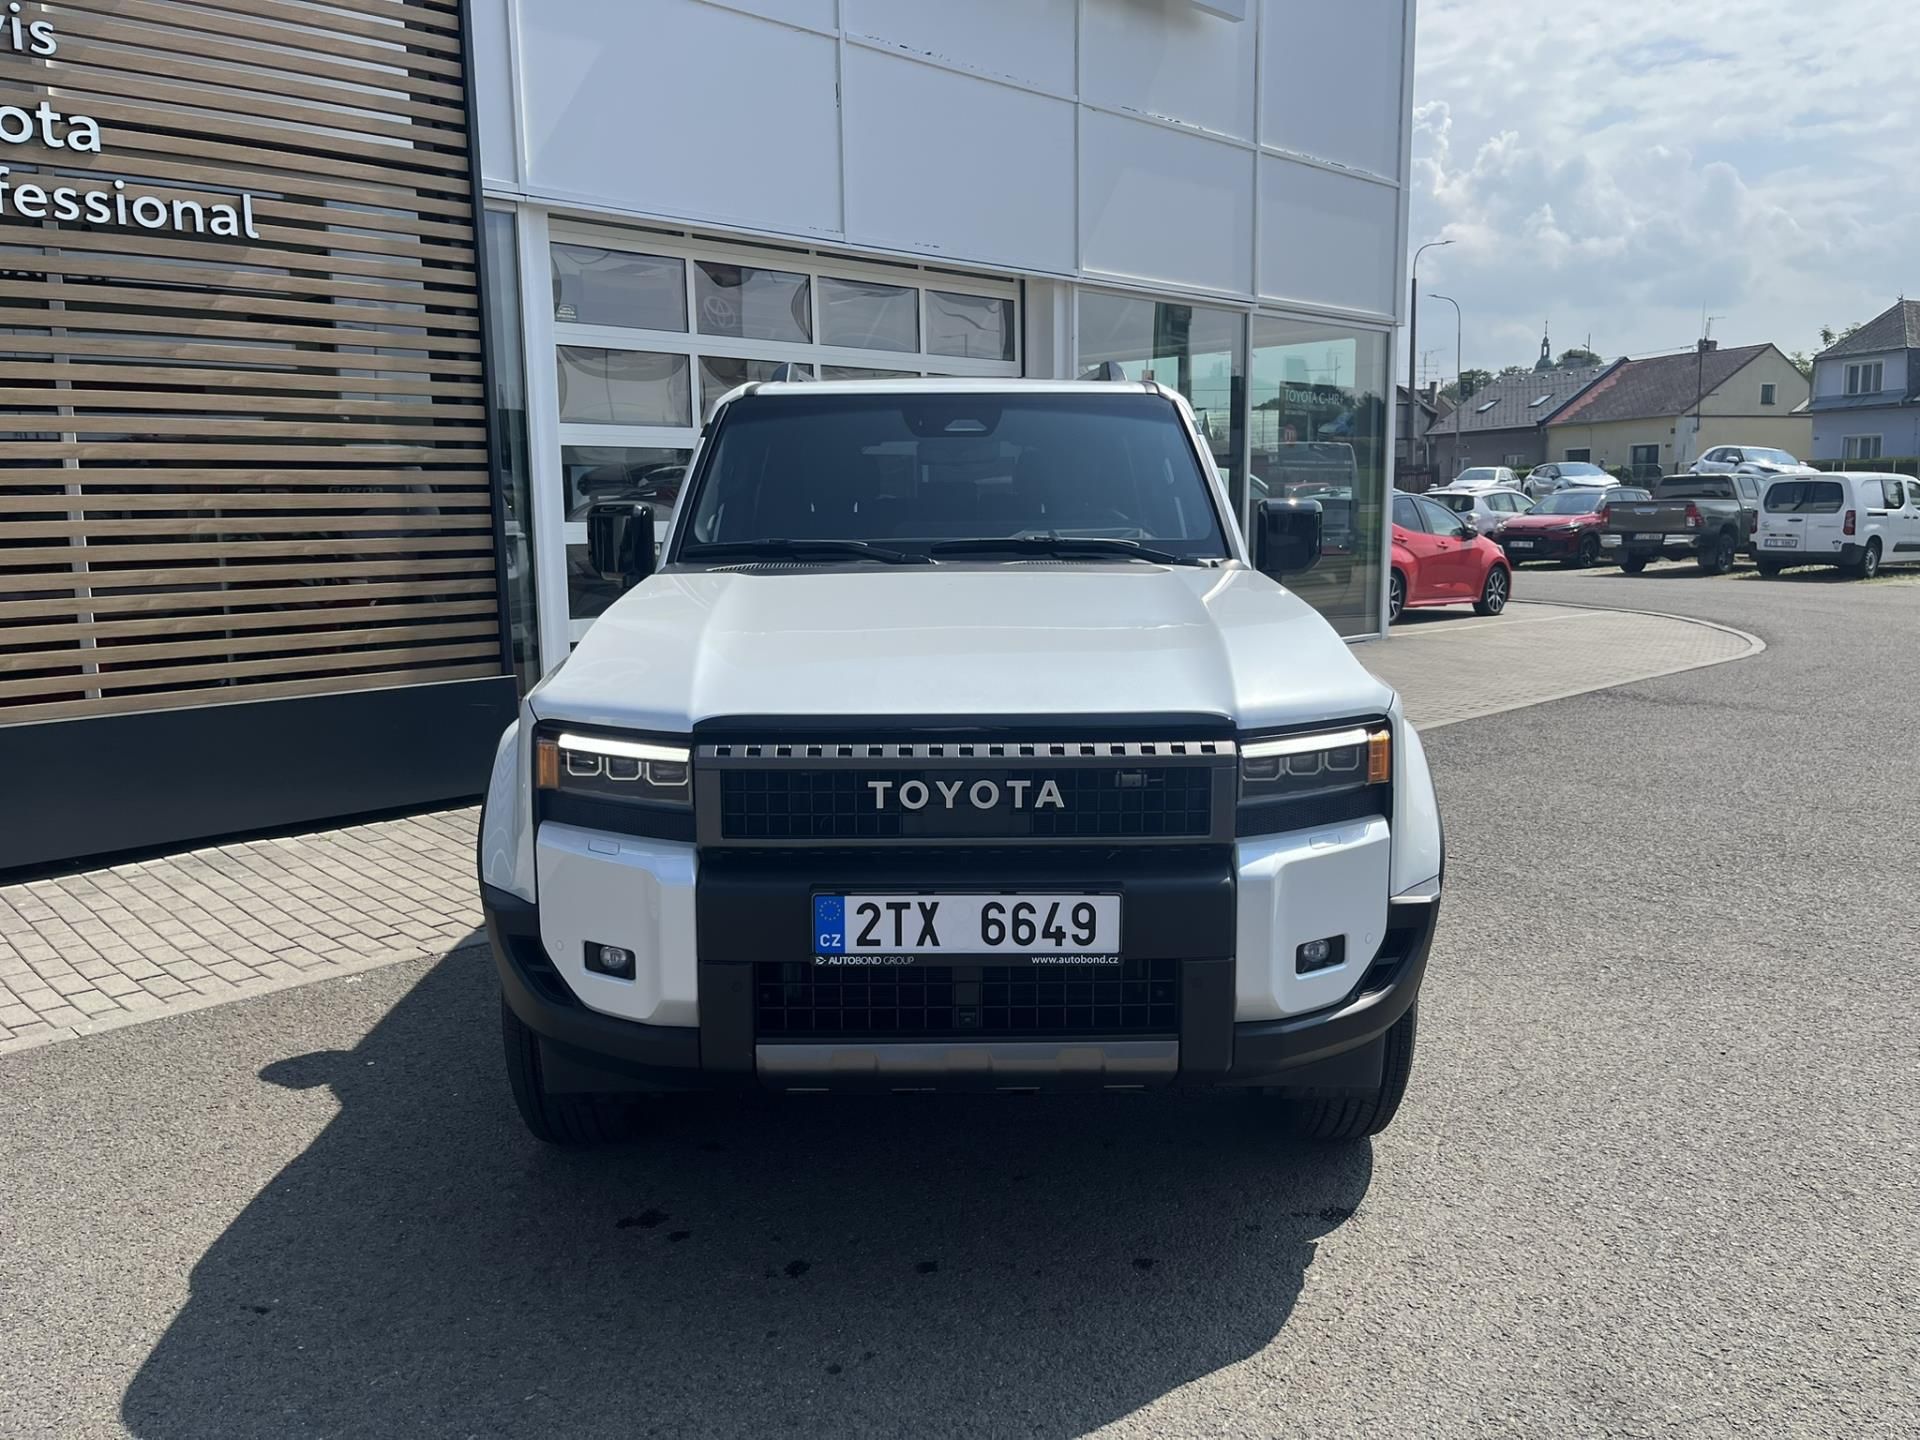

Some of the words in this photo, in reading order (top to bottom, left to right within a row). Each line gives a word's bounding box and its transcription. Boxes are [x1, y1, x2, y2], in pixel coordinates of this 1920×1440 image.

[0, 1, 57, 55] is
[867, 780, 1065, 809] TOYOTA
[856, 901, 940, 947] 2TX
[981, 901, 1097, 947] 6649
[819, 934, 841, 947] CZ
[828, 956, 882, 965] AUTOBOND
[883, 956, 914, 965] GROUP
[1031, 955, 1119, 964] www.autobond.cz
